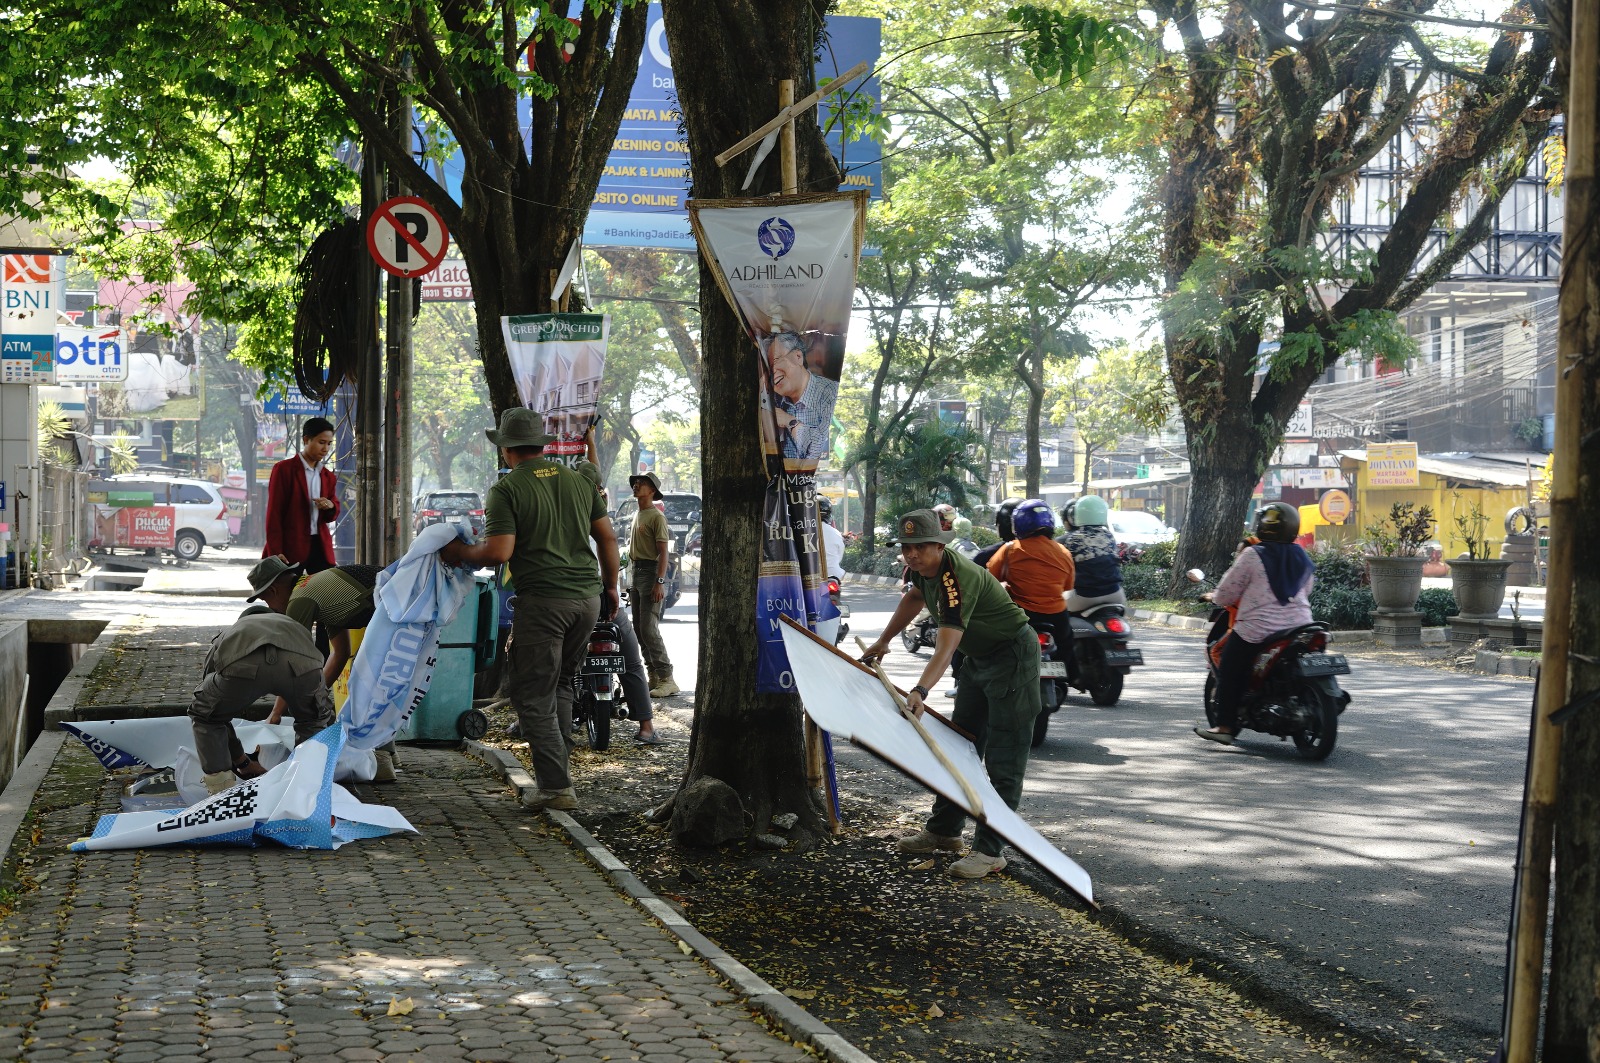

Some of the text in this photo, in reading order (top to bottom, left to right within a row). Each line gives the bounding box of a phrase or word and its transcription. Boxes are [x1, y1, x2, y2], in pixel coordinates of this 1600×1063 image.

[611, 139, 661, 152] KENING
[602, 166, 637, 177] PAJAK
[640, 167, 648, 177] &
[632, 194, 679, 207] ONLINE
[730, 263, 824, 281] ADHILAND
[442, 286, 472, 298] 567
[6, 290, 50, 309] BNI
[3, 341, 31, 352] ATM
[56, 333, 121, 365] btn
[32, 351, 52, 365] 24
[1369, 459, 1415, 470] JOINTLAND
[135, 515, 171, 530] pucuk
